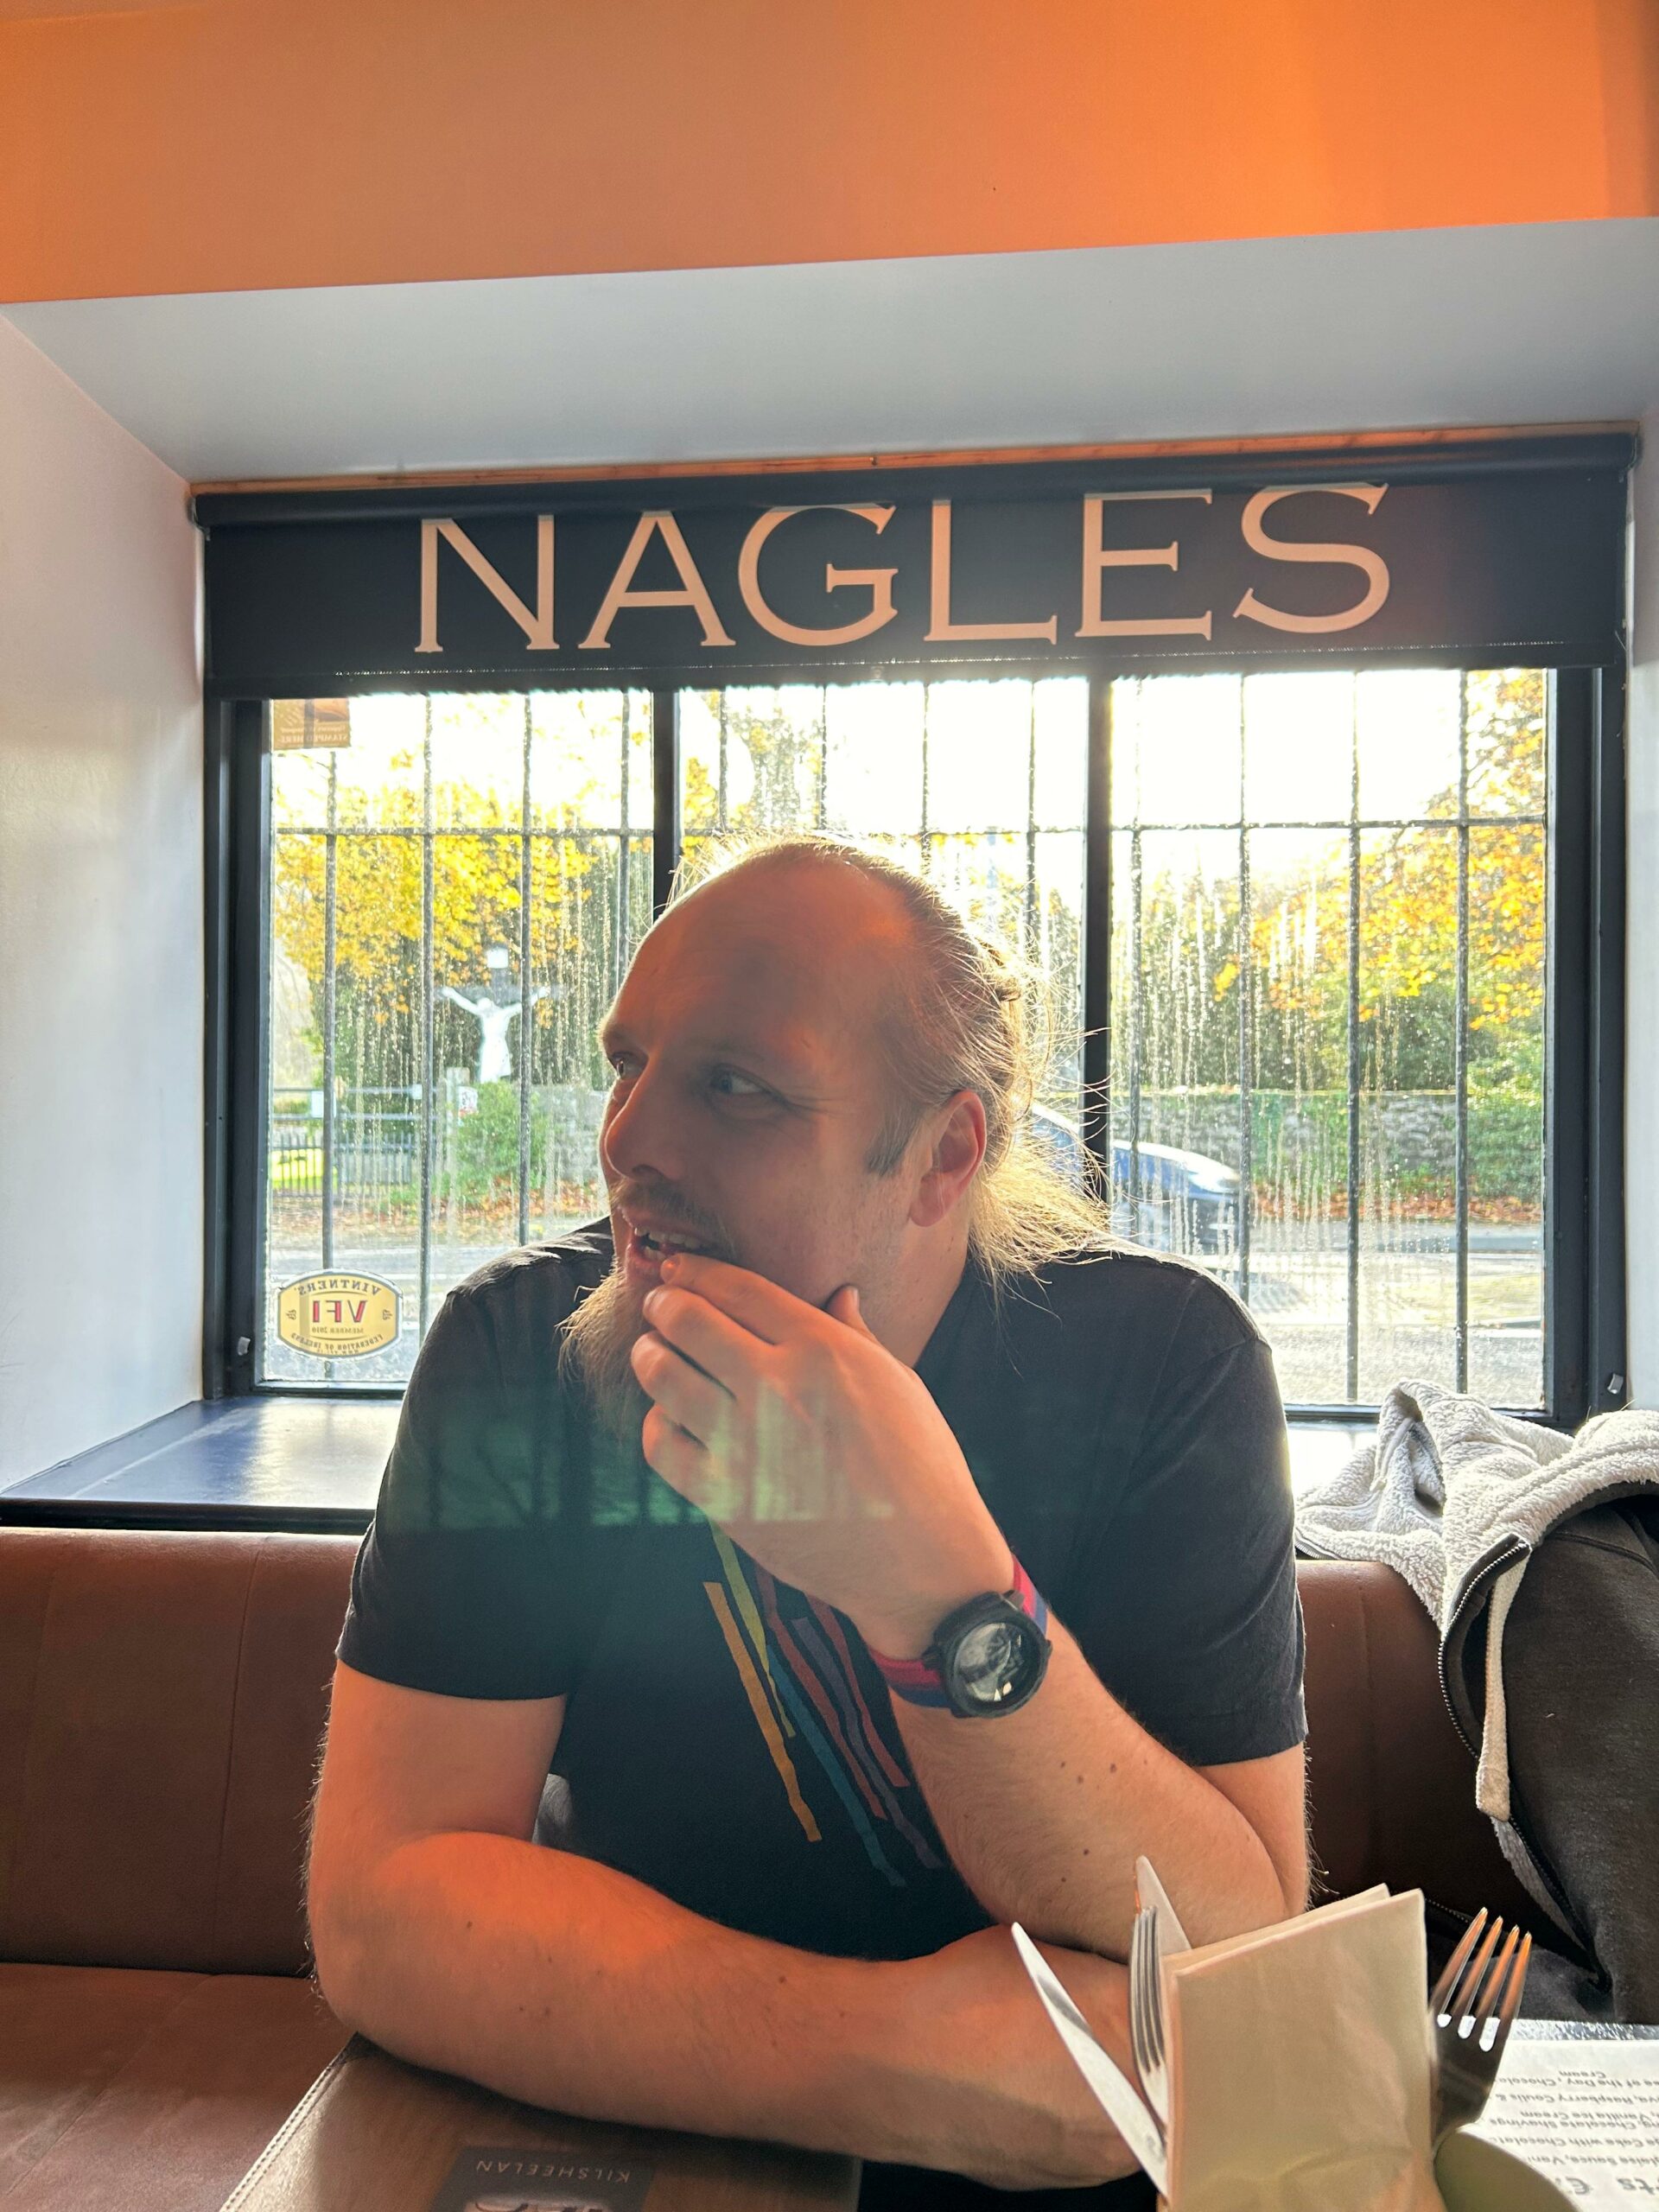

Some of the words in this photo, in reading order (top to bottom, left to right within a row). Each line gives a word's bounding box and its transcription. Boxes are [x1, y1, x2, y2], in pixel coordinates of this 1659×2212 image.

[414, 482, 1389, 654] NAGLES
[1559, 2069, 1606, 2079] Cream
[1495, 2076, 1557, 2087] Chocola
[1598, 2079, 1623, 2088] the
[1626, 2079, 1641, 2088] of
[1510, 2094, 1557, 2103] Coulis
[1558, 2094, 1634, 2105] Raspberry
[1520, 2111, 1569, 2120] Cream
[1573, 2112, 1592, 2120] Ice
[1596, 2112, 1651, 2123] Vanilla
[1490, 2118, 1559, 2129] Shavings
[1561, 2120, 1637, 2130] Chocolate
[1493, 2136, 1567, 2147] Chocolat
[1569, 2137, 1603, 2147] with
[1606, 2137, 1643, 2147] Cake
[475, 2159, 631, 2183] KILSHEELAN
